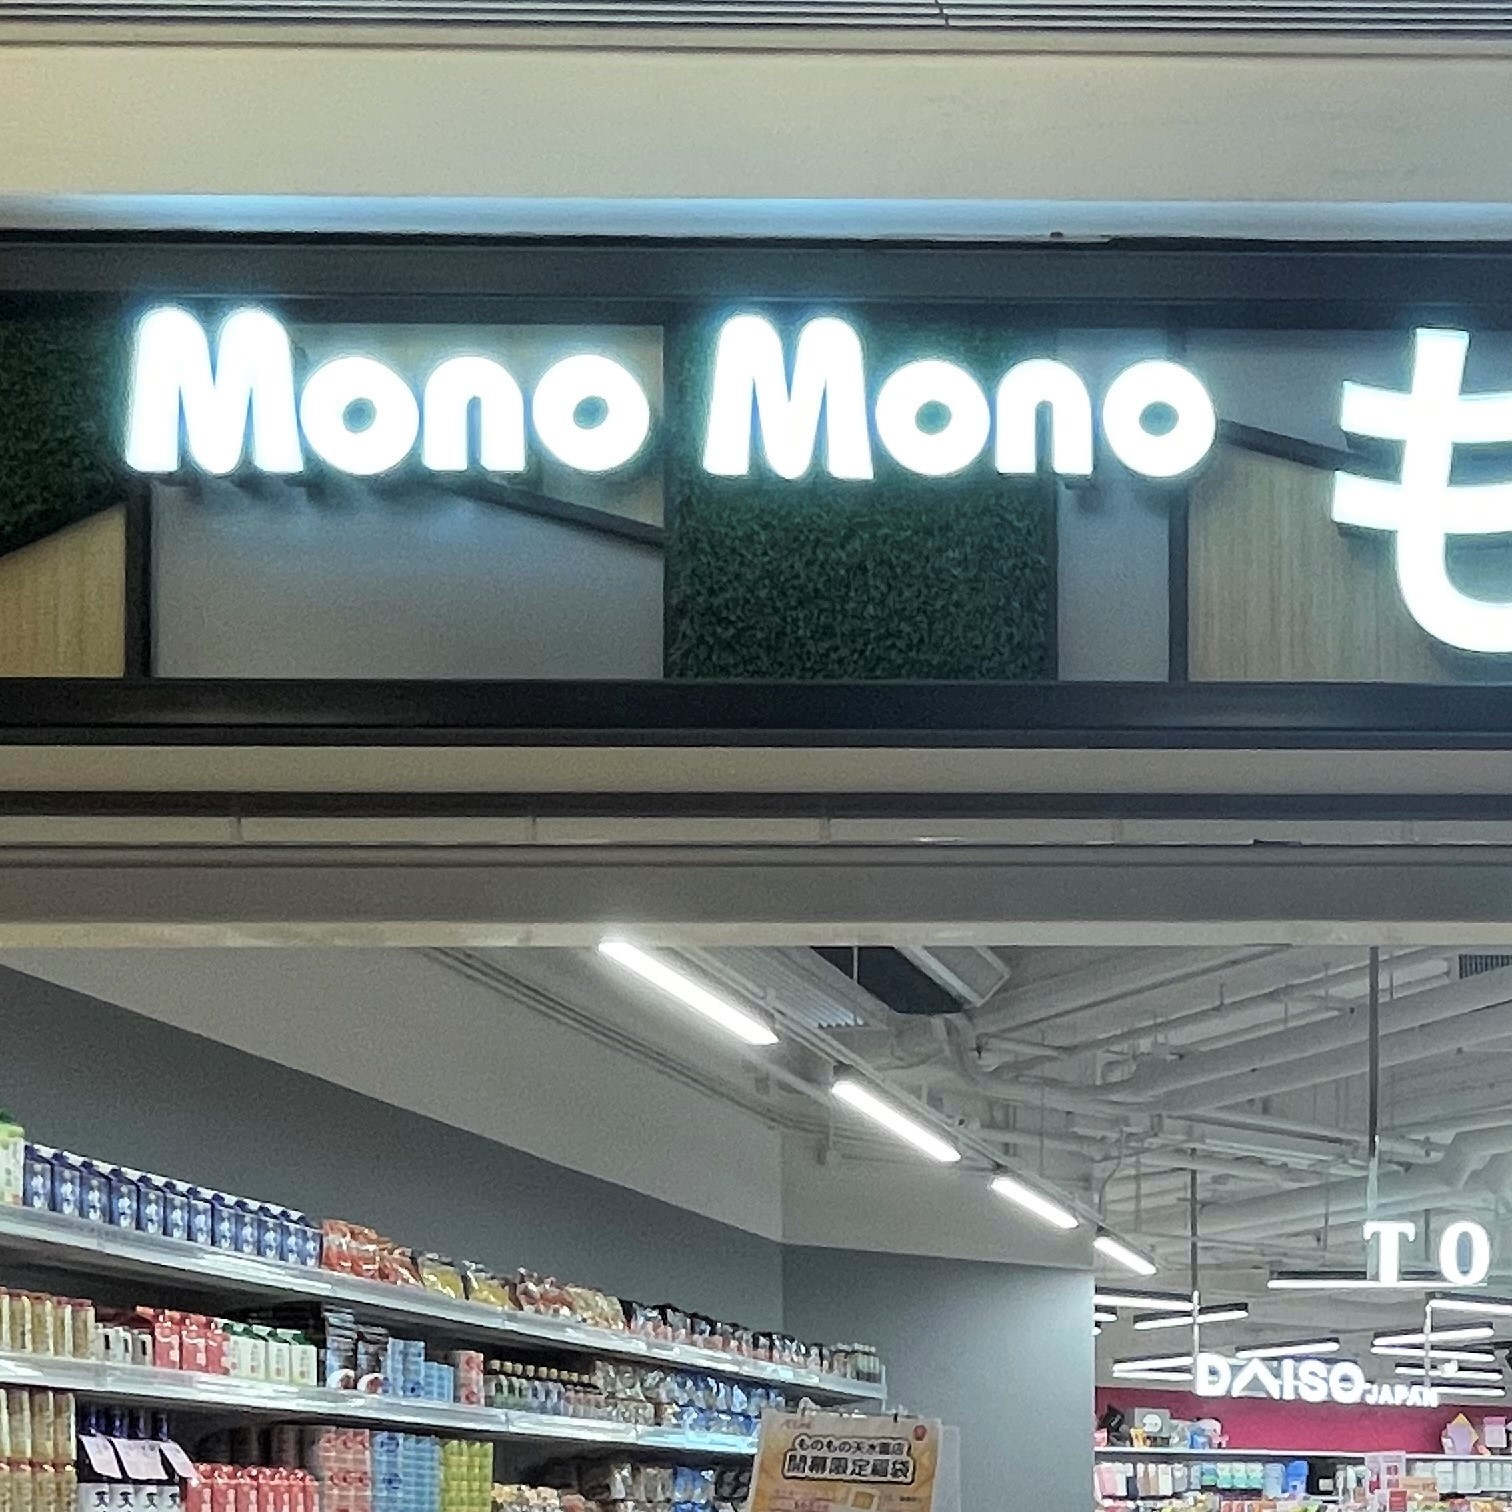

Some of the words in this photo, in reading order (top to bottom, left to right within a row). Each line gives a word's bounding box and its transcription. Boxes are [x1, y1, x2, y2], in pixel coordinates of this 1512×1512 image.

[124, 305, 650, 475] Mono
[703, 313, 1217, 479] Mono
[1196, 1352, 1365, 1404] DAISO
[1365, 1383, 1440, 1407] JAPAN
